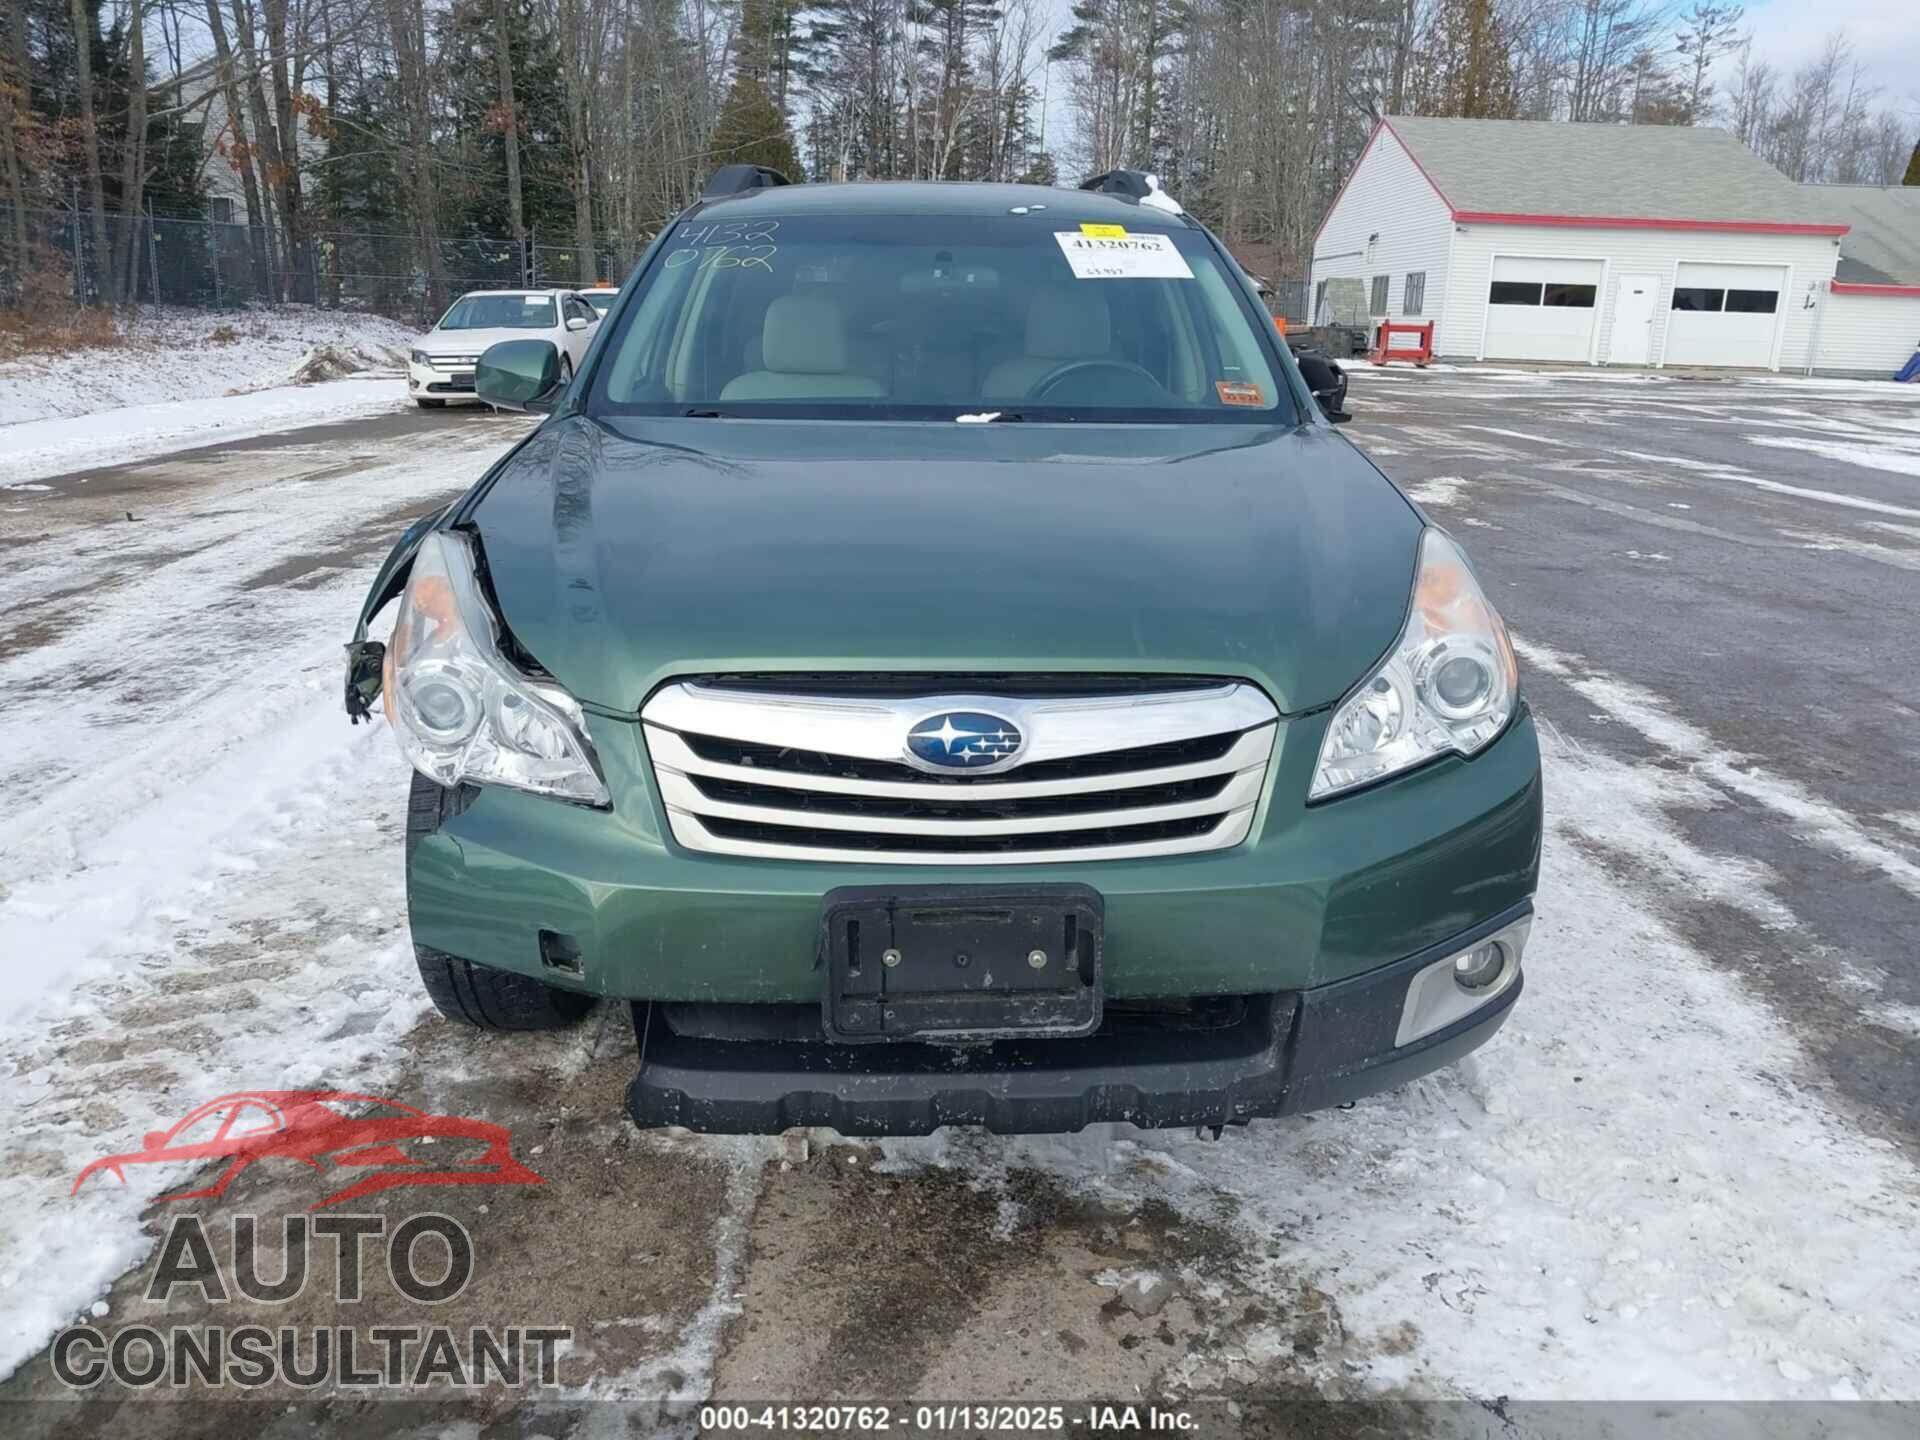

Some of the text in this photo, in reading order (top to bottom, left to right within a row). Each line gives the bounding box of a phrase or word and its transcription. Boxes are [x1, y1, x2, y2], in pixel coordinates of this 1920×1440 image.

[680, 221, 780, 246] 4132
[1073, 239, 1164, 251] 41320762
[664, 244, 778, 273] 0762
